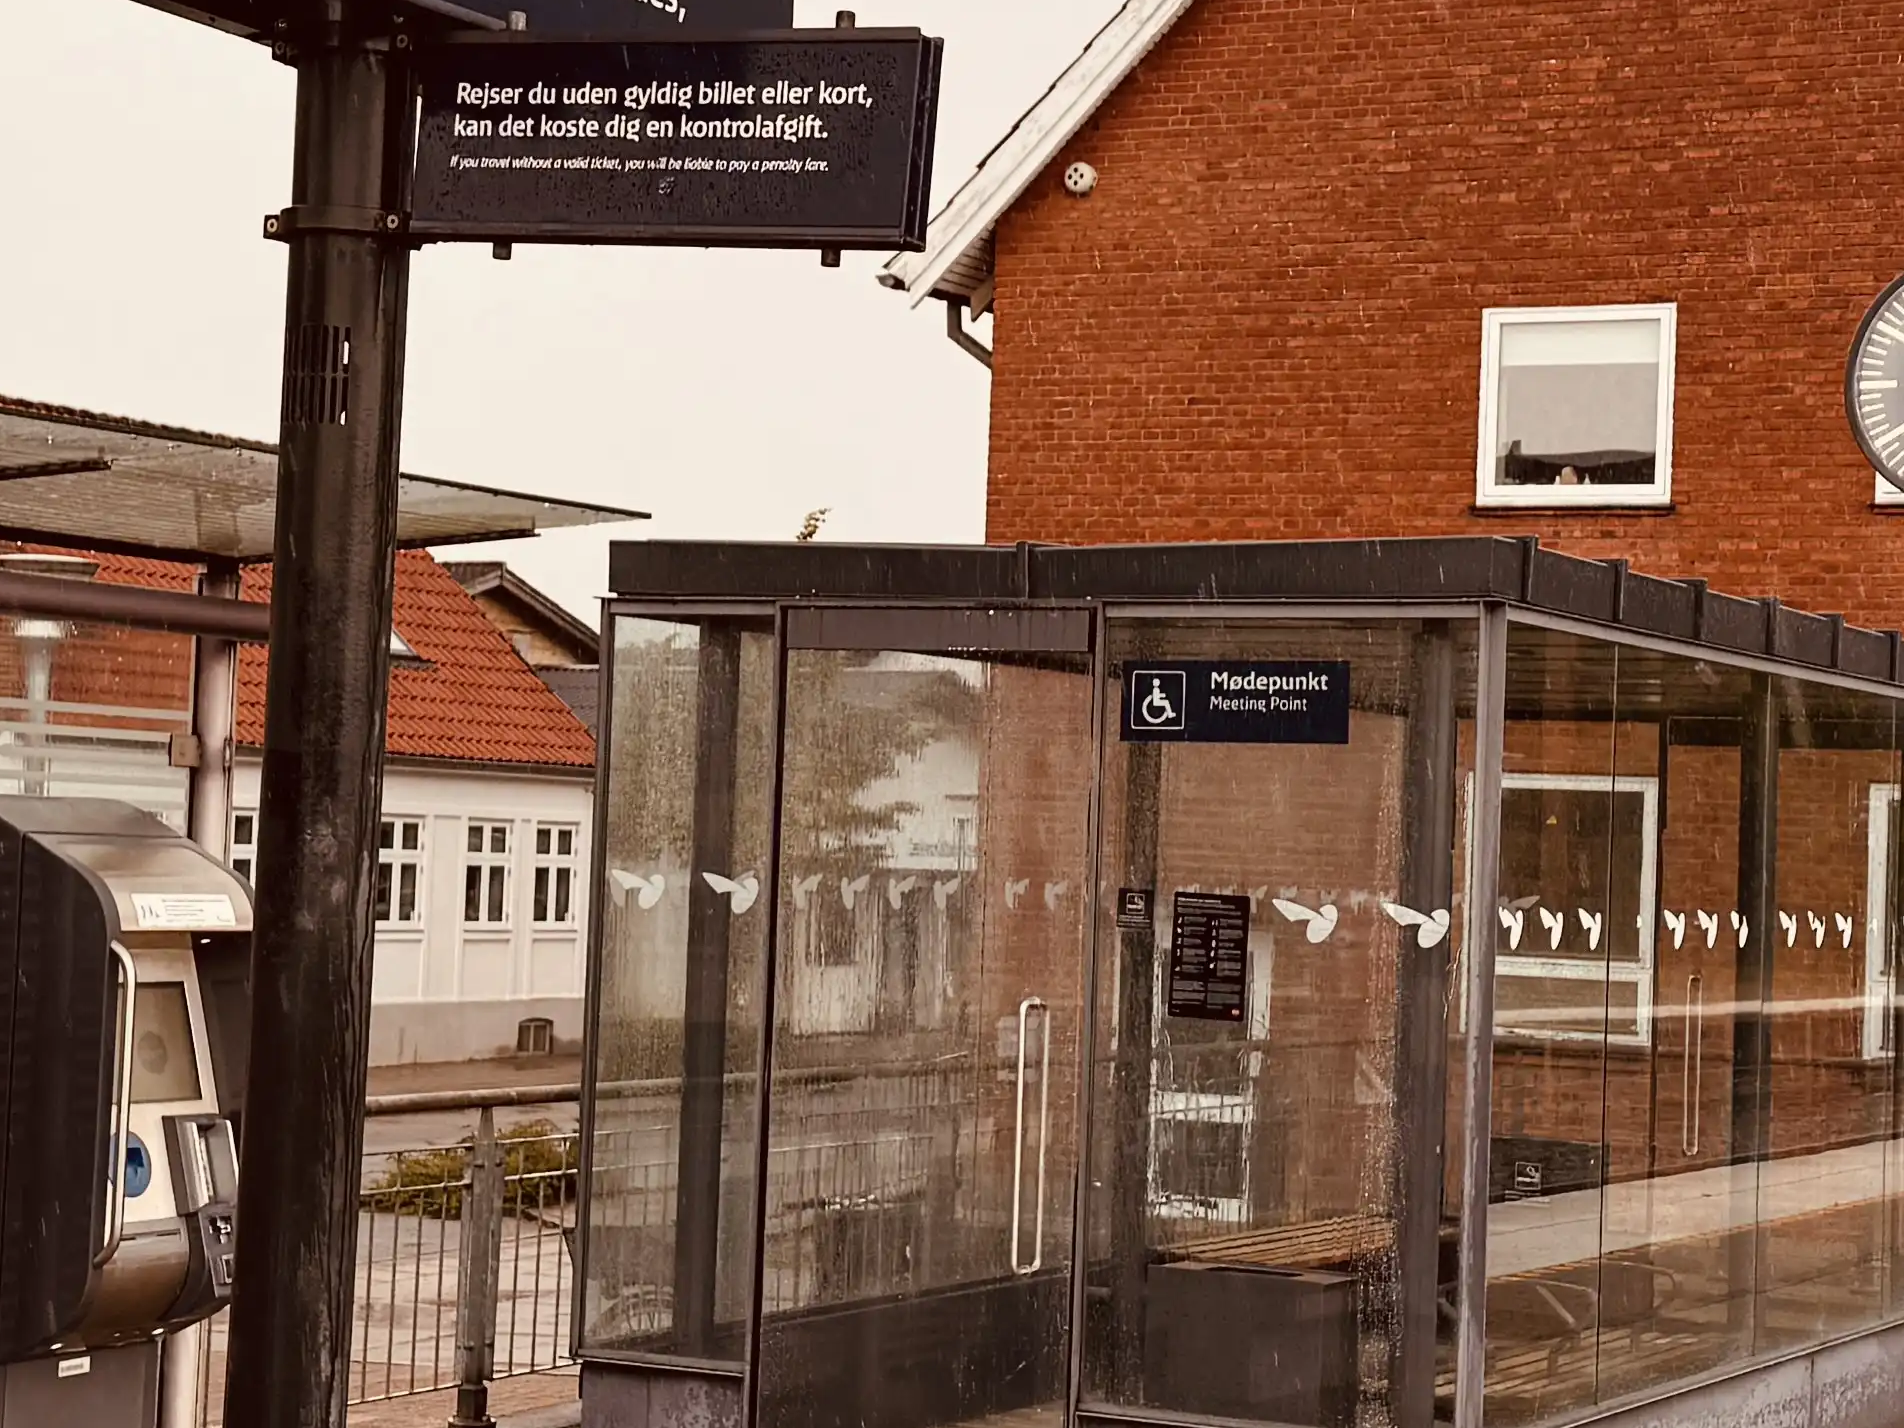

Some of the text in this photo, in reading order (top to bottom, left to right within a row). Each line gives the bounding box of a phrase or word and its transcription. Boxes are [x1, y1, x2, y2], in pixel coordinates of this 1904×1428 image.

[457, 81, 872, 110] Rejser du uden gyldig billet eller kort,
[455, 114, 828, 142] kan det koste dig en kontrolafgift.
[450, 155, 828, 173] If you travel without a valid ticket, you will be liable to pay a penalty fare.
[1212, 672, 1328, 694] Mødepunkt
[1211, 697, 1306, 713] Meeting Point
